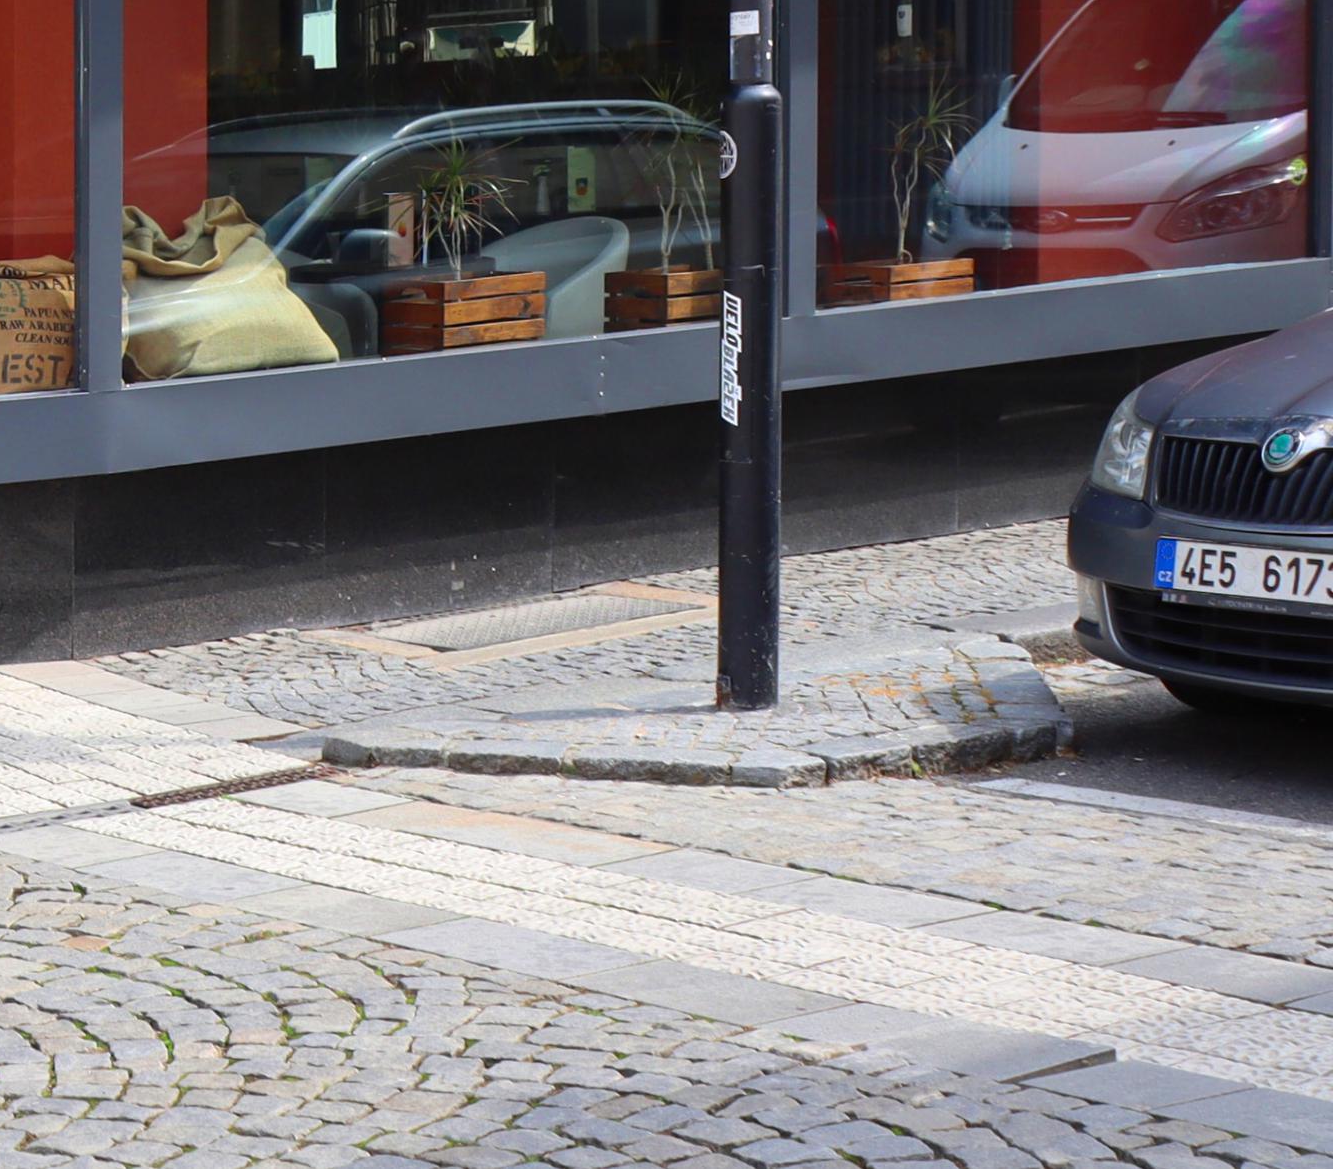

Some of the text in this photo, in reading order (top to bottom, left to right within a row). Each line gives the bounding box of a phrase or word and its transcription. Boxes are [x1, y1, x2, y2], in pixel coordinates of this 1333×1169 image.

[23, 306, 60, 319] PAPUA
[14, 333, 72, 347] CLEAN SOU
[1180, 547, 1238, 589] 4E5
[1157, 570, 1173, 583] CZ
